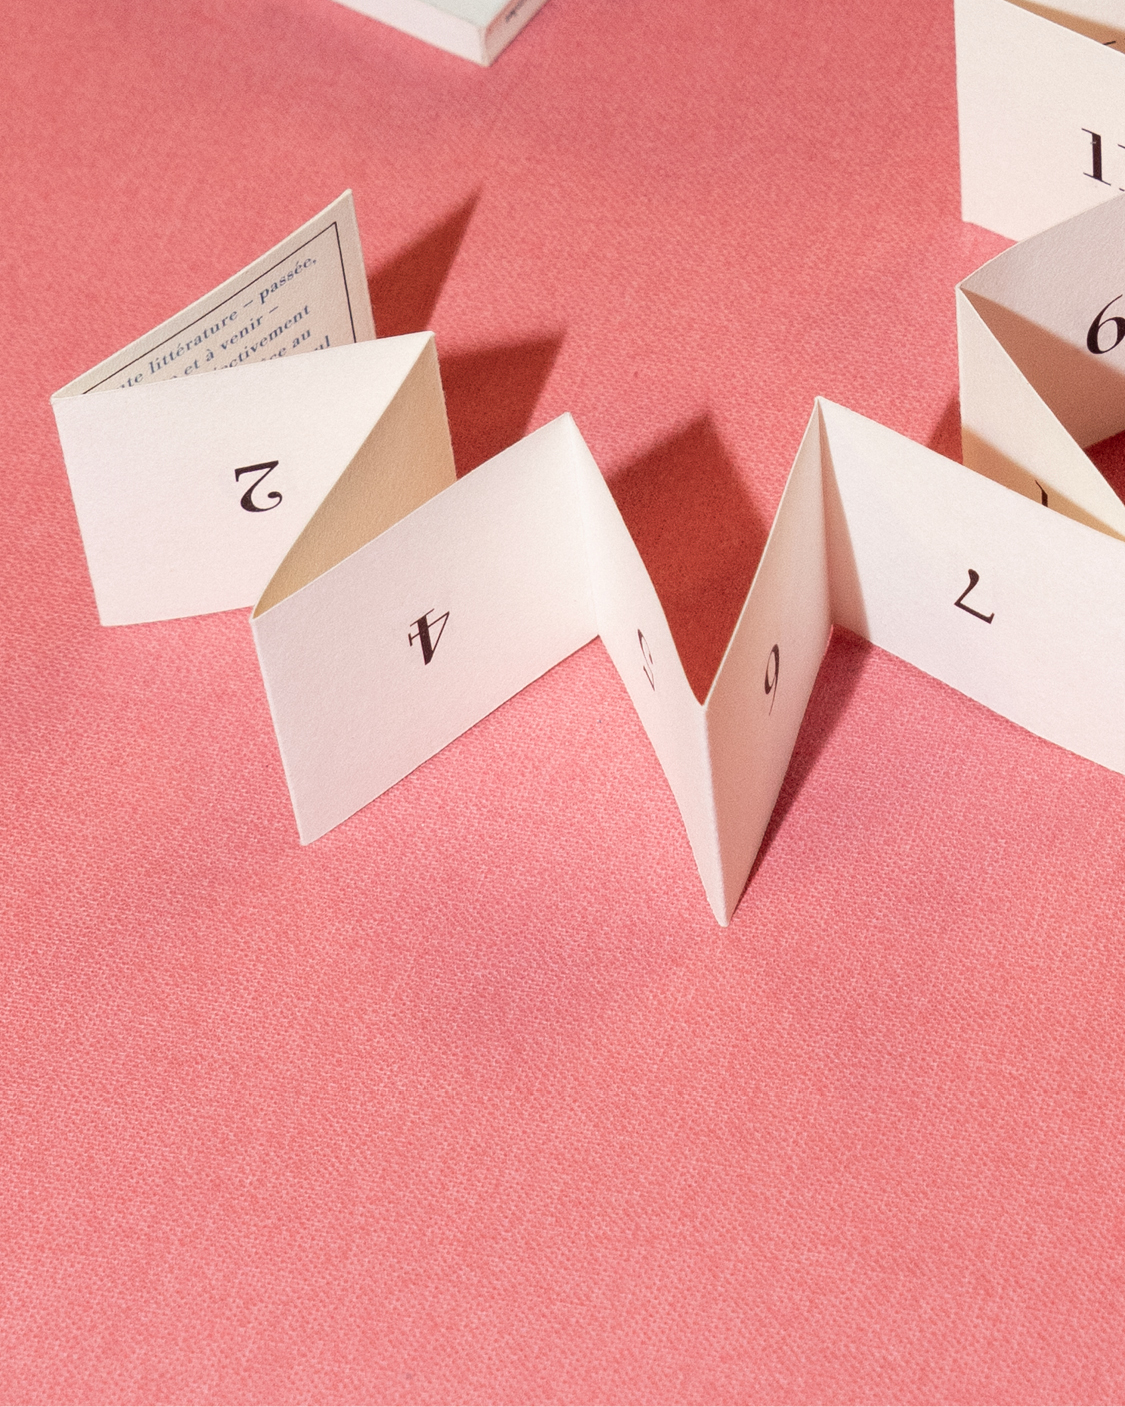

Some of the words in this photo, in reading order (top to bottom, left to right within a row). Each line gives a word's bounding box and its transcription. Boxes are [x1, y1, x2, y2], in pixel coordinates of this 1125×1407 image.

[149, 310, 238, 374] littérature
[259, 256, 317, 305] passée,
[293, 330, 311, 349] au
[184, 359, 200, 375] et
[205, 348, 215, 362] à
[220, 315, 264, 350] venir
[234, 460, 283, 513] 2
[953, 568, 995, 625] 7
[407, 607, 450, 666] 4
